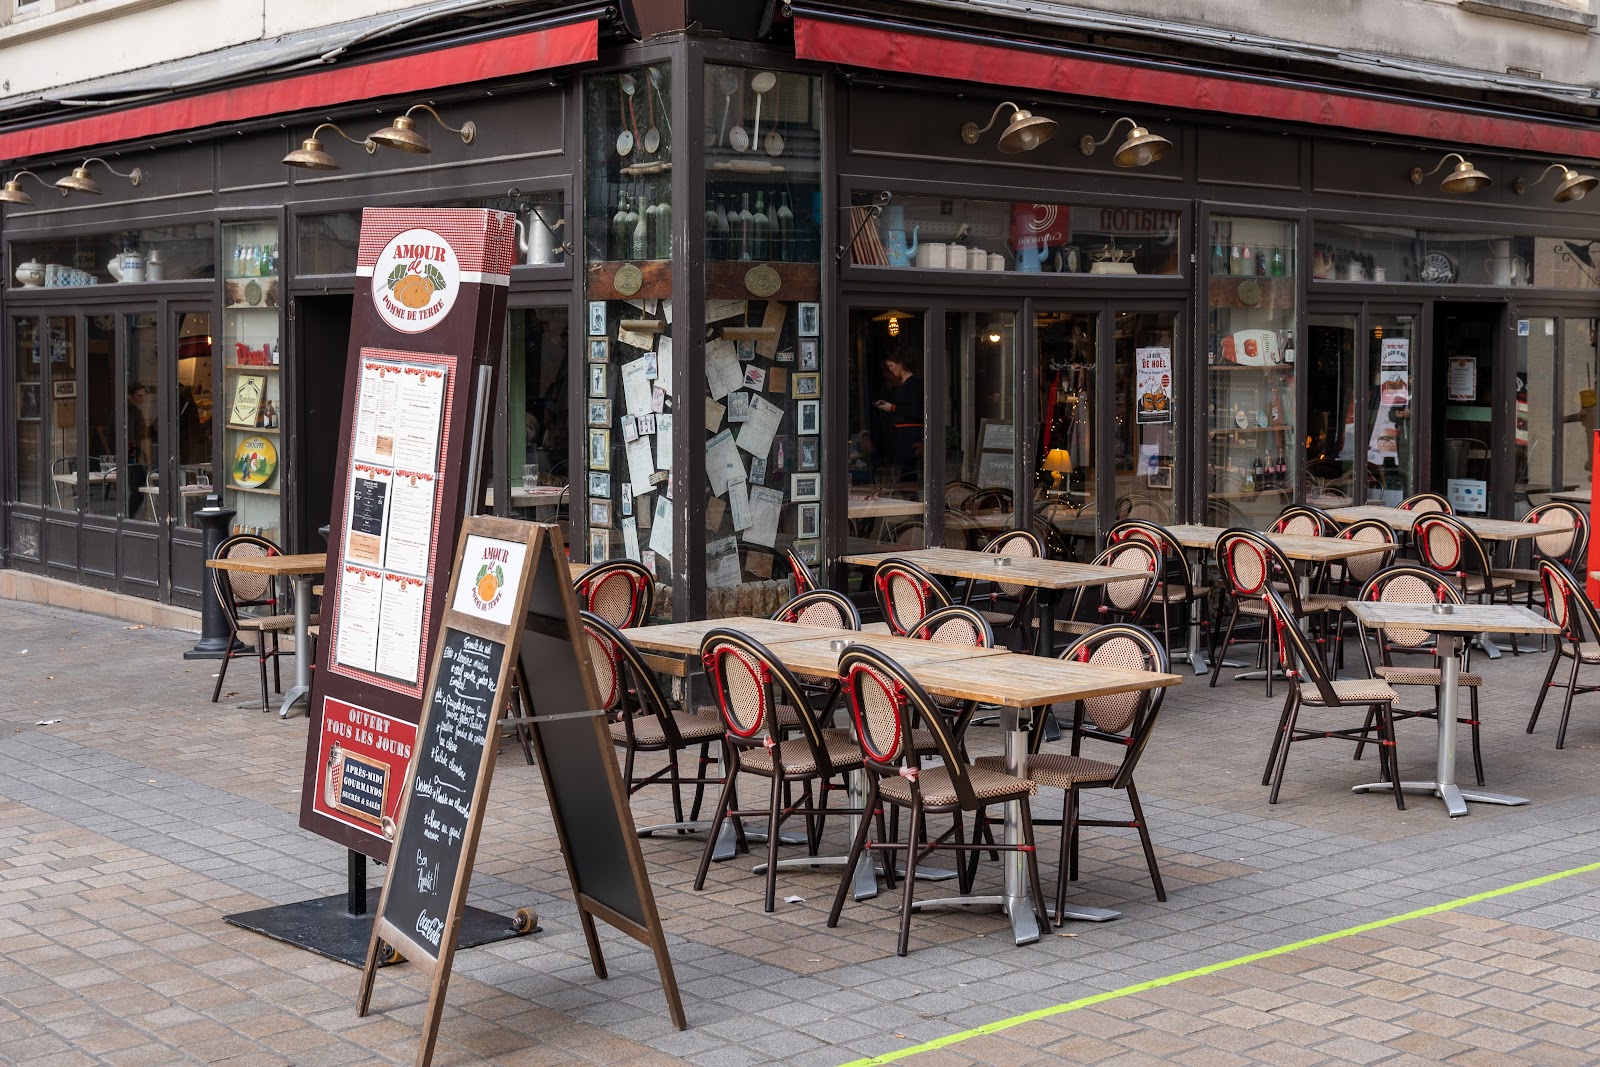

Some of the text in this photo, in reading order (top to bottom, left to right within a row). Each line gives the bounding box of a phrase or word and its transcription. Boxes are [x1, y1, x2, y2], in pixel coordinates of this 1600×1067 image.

[392, 244, 446, 263] AMOUR
[407, 256, 423, 274] de
[382, 294, 445, 321] POMME DE TERRE
[1142, 357, 1167, 369] DE NOËL
[482, 547, 509, 564] AMOUR
[487, 560, 496, 573] de
[471, 586, 502, 611] POMME DE TERRE
[348, 708, 391, 734] OUVERT
[326, 717, 412, 759] TOUS LES JOURS
[345, 763, 383, 785] APRÈS-MIDI
[343, 776, 383, 798] GOURMANDS
[341, 790, 361, 804] SUCRÉS
[365, 799, 381, 811] SALÉS
